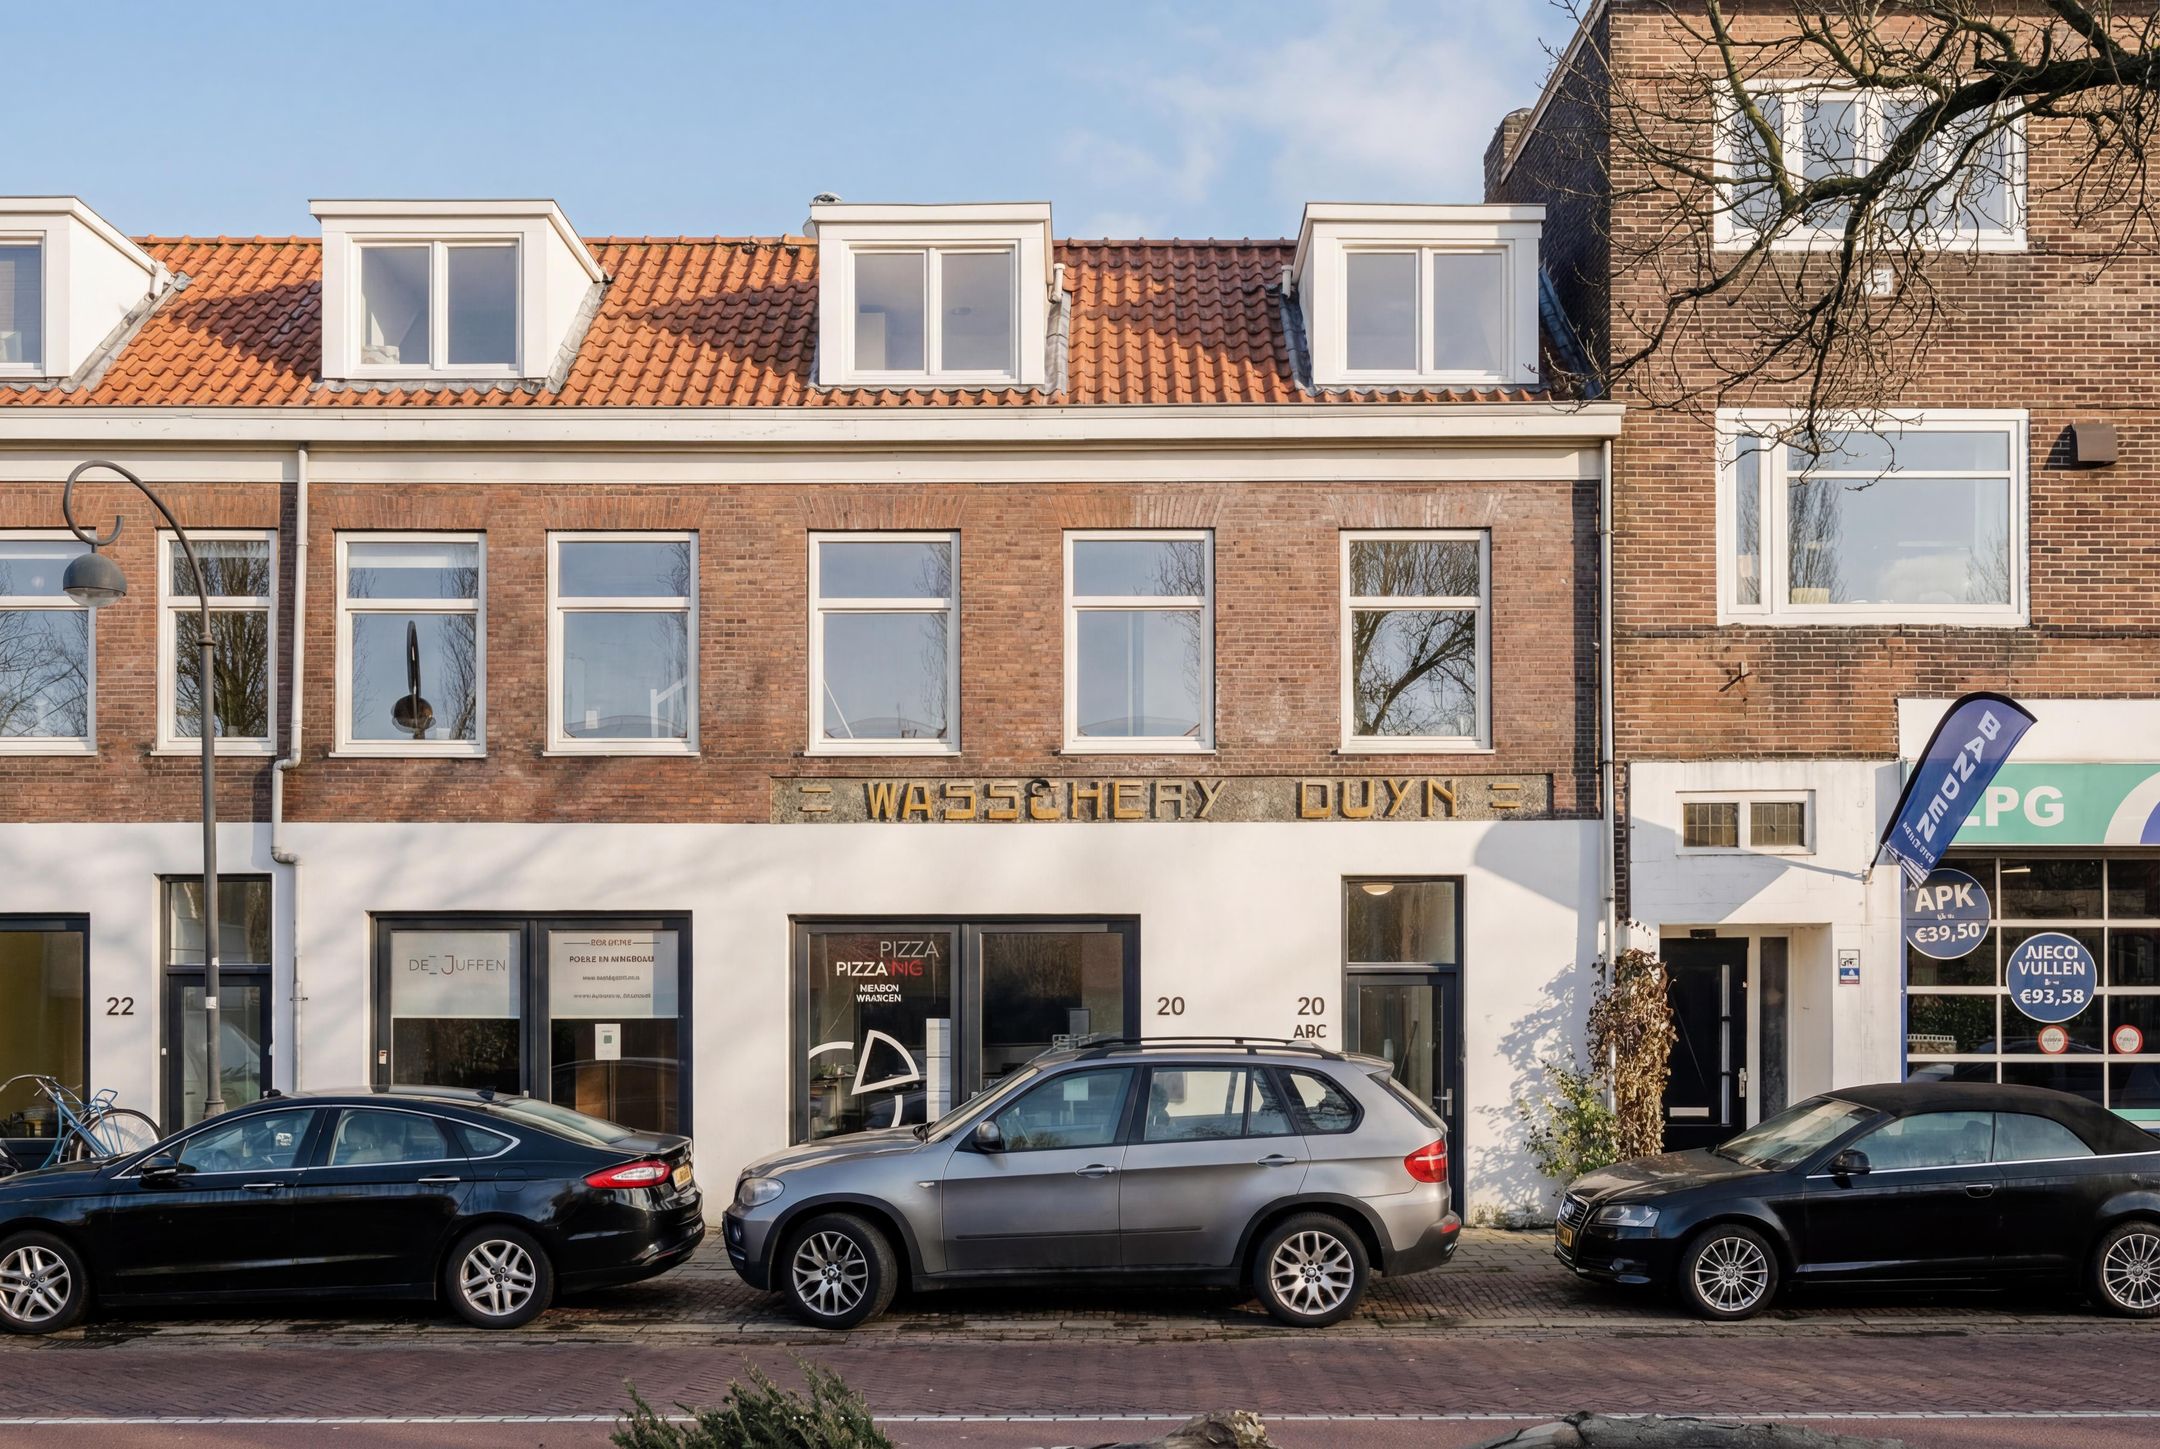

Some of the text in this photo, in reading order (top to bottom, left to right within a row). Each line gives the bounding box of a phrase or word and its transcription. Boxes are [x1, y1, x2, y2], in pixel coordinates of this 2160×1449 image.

[1916, 710, 2001, 843] BANDEN
[1297, 778, 1458, 819] DUYN
[1961, 785, 2065, 827] PG
[1914, 882, 1976, 913] APK
[1914, 922, 1981, 943] €39,50
[880, 940, 940, 958] PIZZA
[836, 961, 888, 977] PIZZA
[2018, 961, 2086, 976] VULLEN
[106, 996, 135, 1016] 22
[1157, 996, 1186, 1016] 20
[1297, 996, 1326, 1016] 20
[2020, 988, 2085, 1006] €93,58
[1293, 1023, 1328, 1039] ABC
